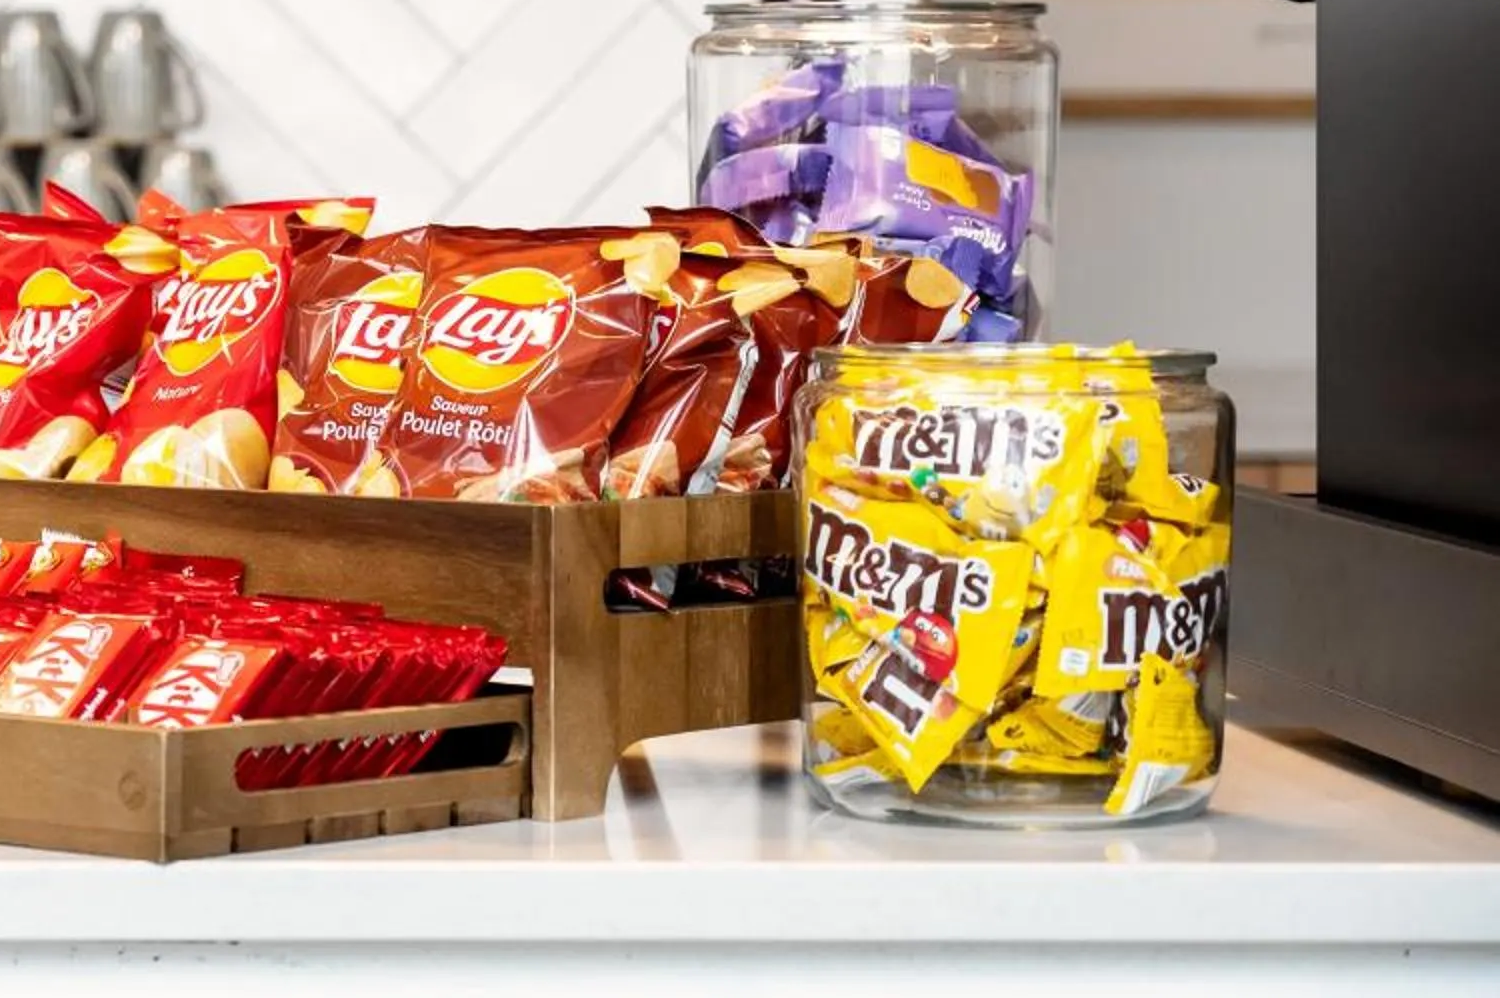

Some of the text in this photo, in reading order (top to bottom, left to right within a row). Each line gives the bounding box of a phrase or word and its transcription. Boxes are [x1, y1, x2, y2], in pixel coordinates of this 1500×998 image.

[158, 271, 271, 343] Lay's
[429, 295, 567, 366] Lay's
[430, 395, 488, 416] Saveur
[323, 421, 381, 441] Poule
[400, 411, 512, 445] Poulet Rôti
